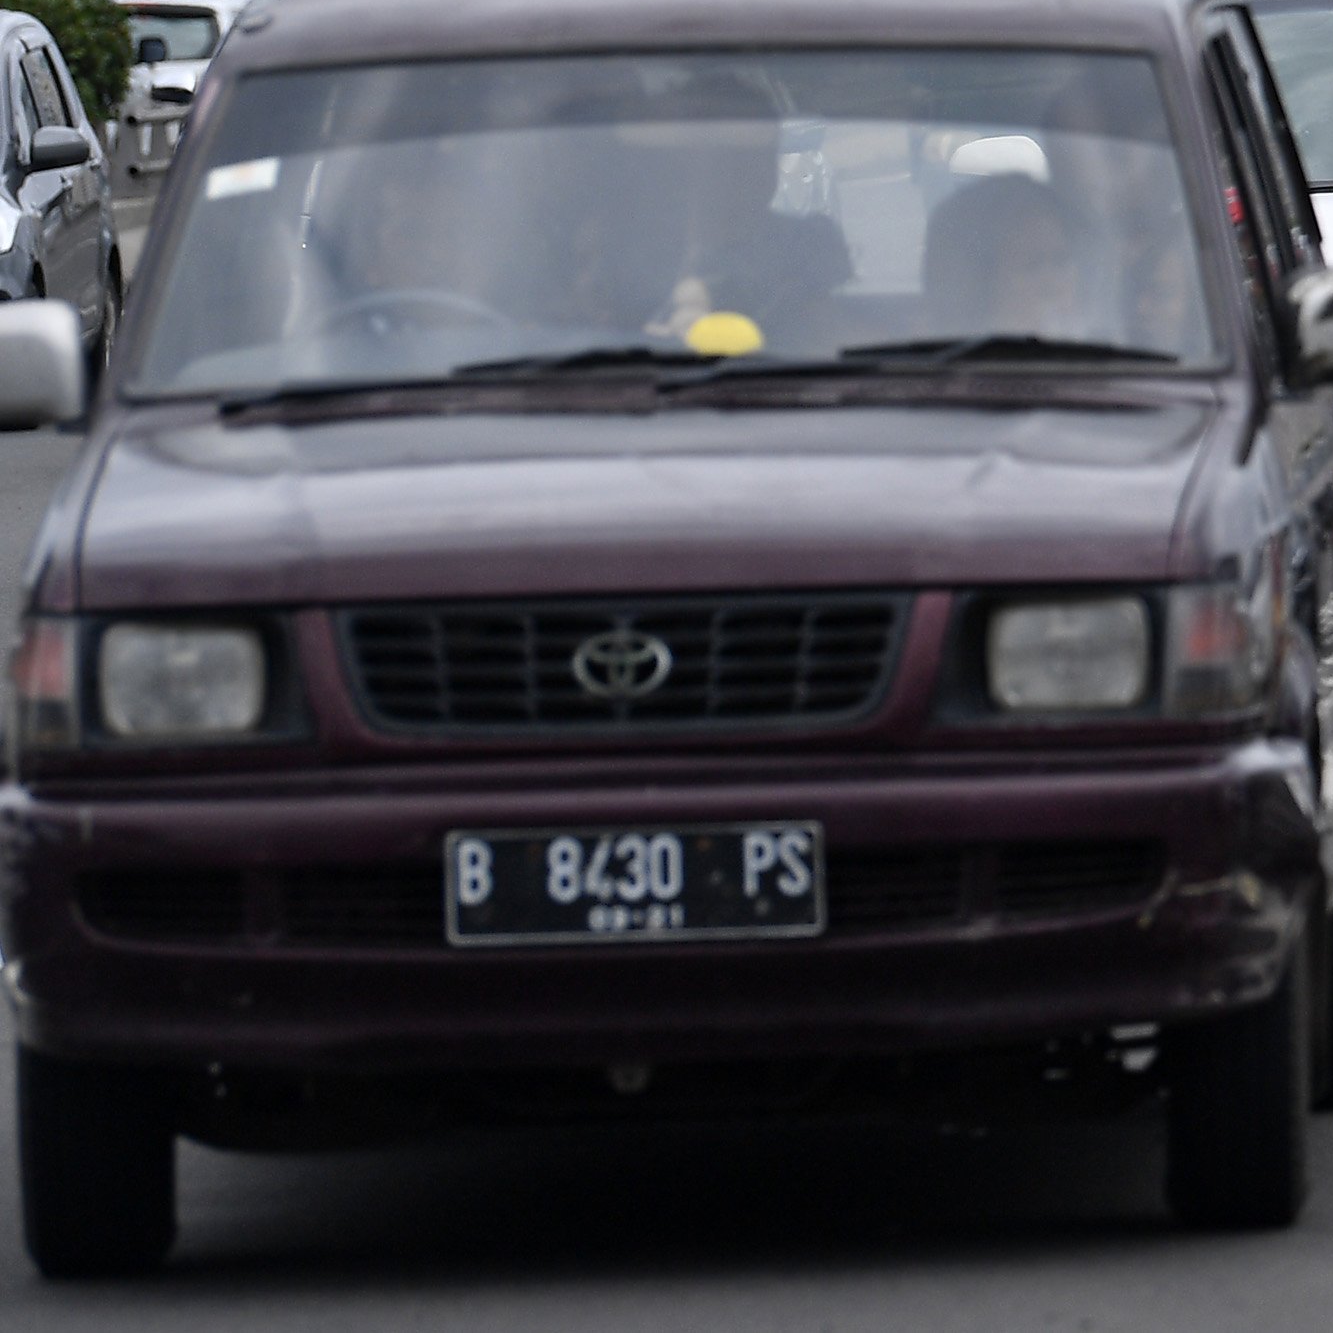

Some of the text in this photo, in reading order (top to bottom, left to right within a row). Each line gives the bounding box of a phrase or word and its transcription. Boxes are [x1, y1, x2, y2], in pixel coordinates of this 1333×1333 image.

[458, 828, 812, 906] B 8430 PS
